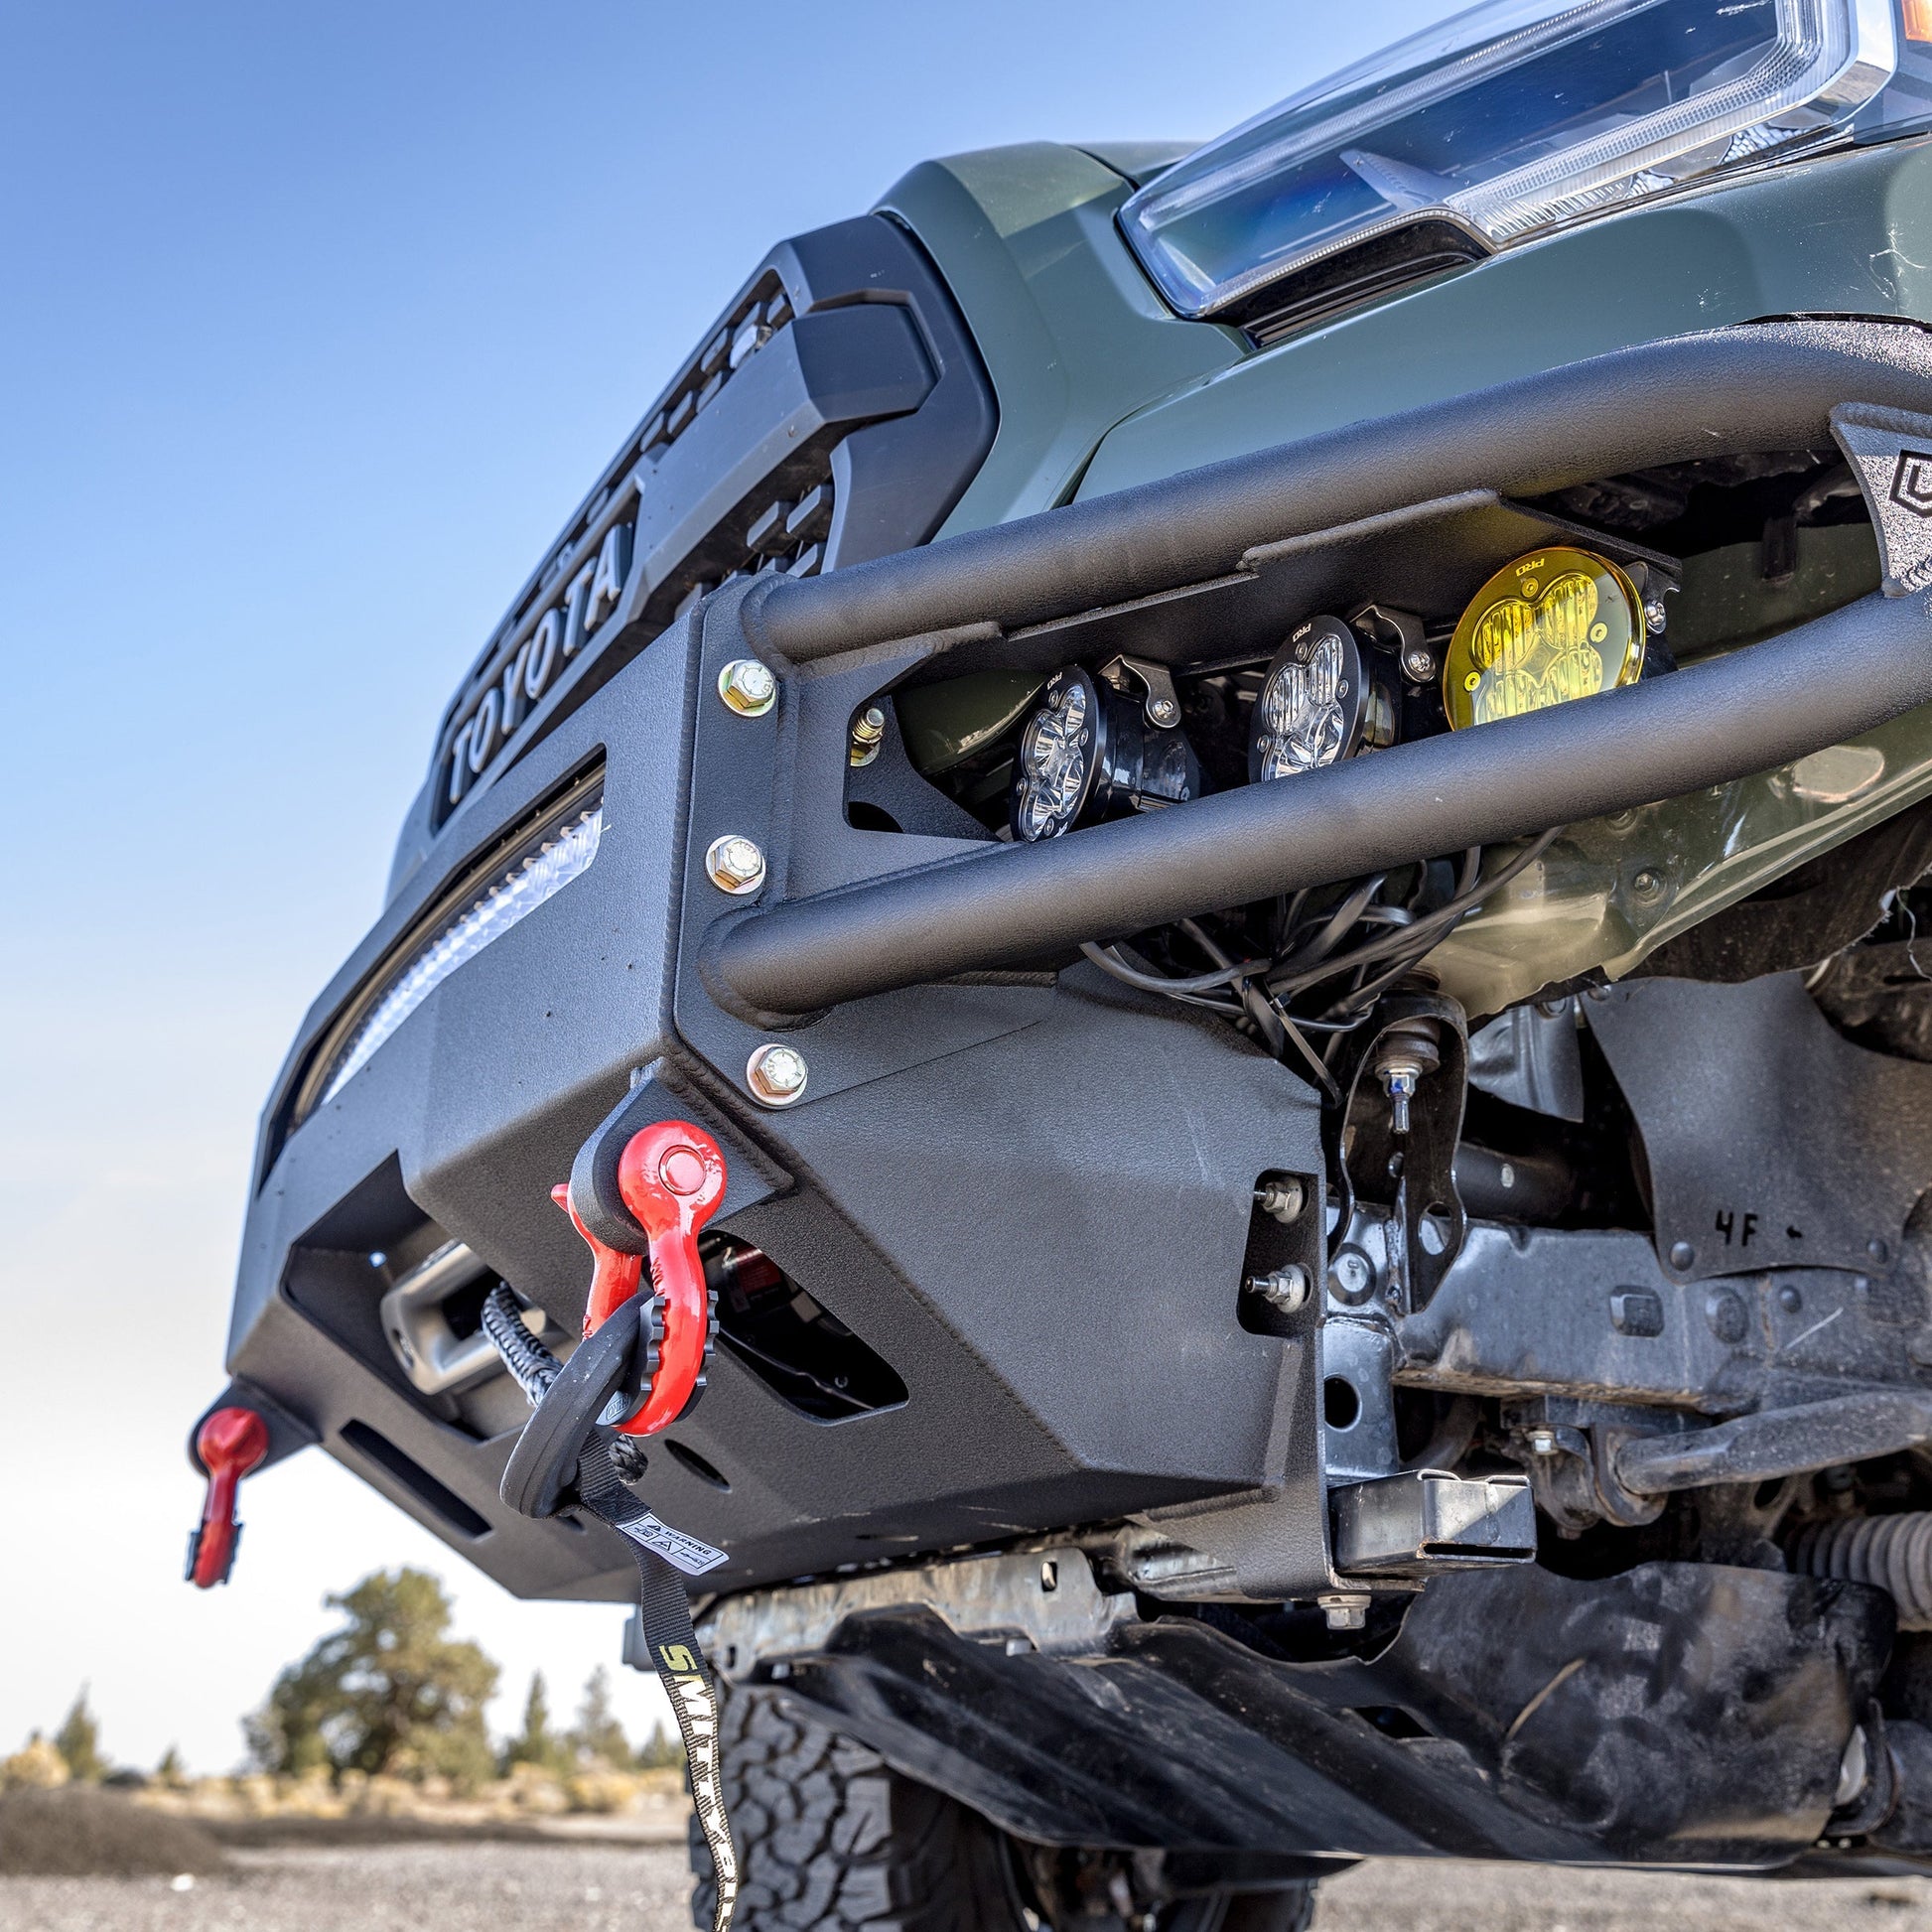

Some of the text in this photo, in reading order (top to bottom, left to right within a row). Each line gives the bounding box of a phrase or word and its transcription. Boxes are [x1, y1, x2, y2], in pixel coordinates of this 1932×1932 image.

[1515, 558, 1545, 577] PRO
[1293, 622, 1311, 642] PRO
[450, 524, 627, 804] TOYOTA
[664, 1531, 712, 1556] WARNING
[658, 1644, 737, 1932] SMITTYBIL
